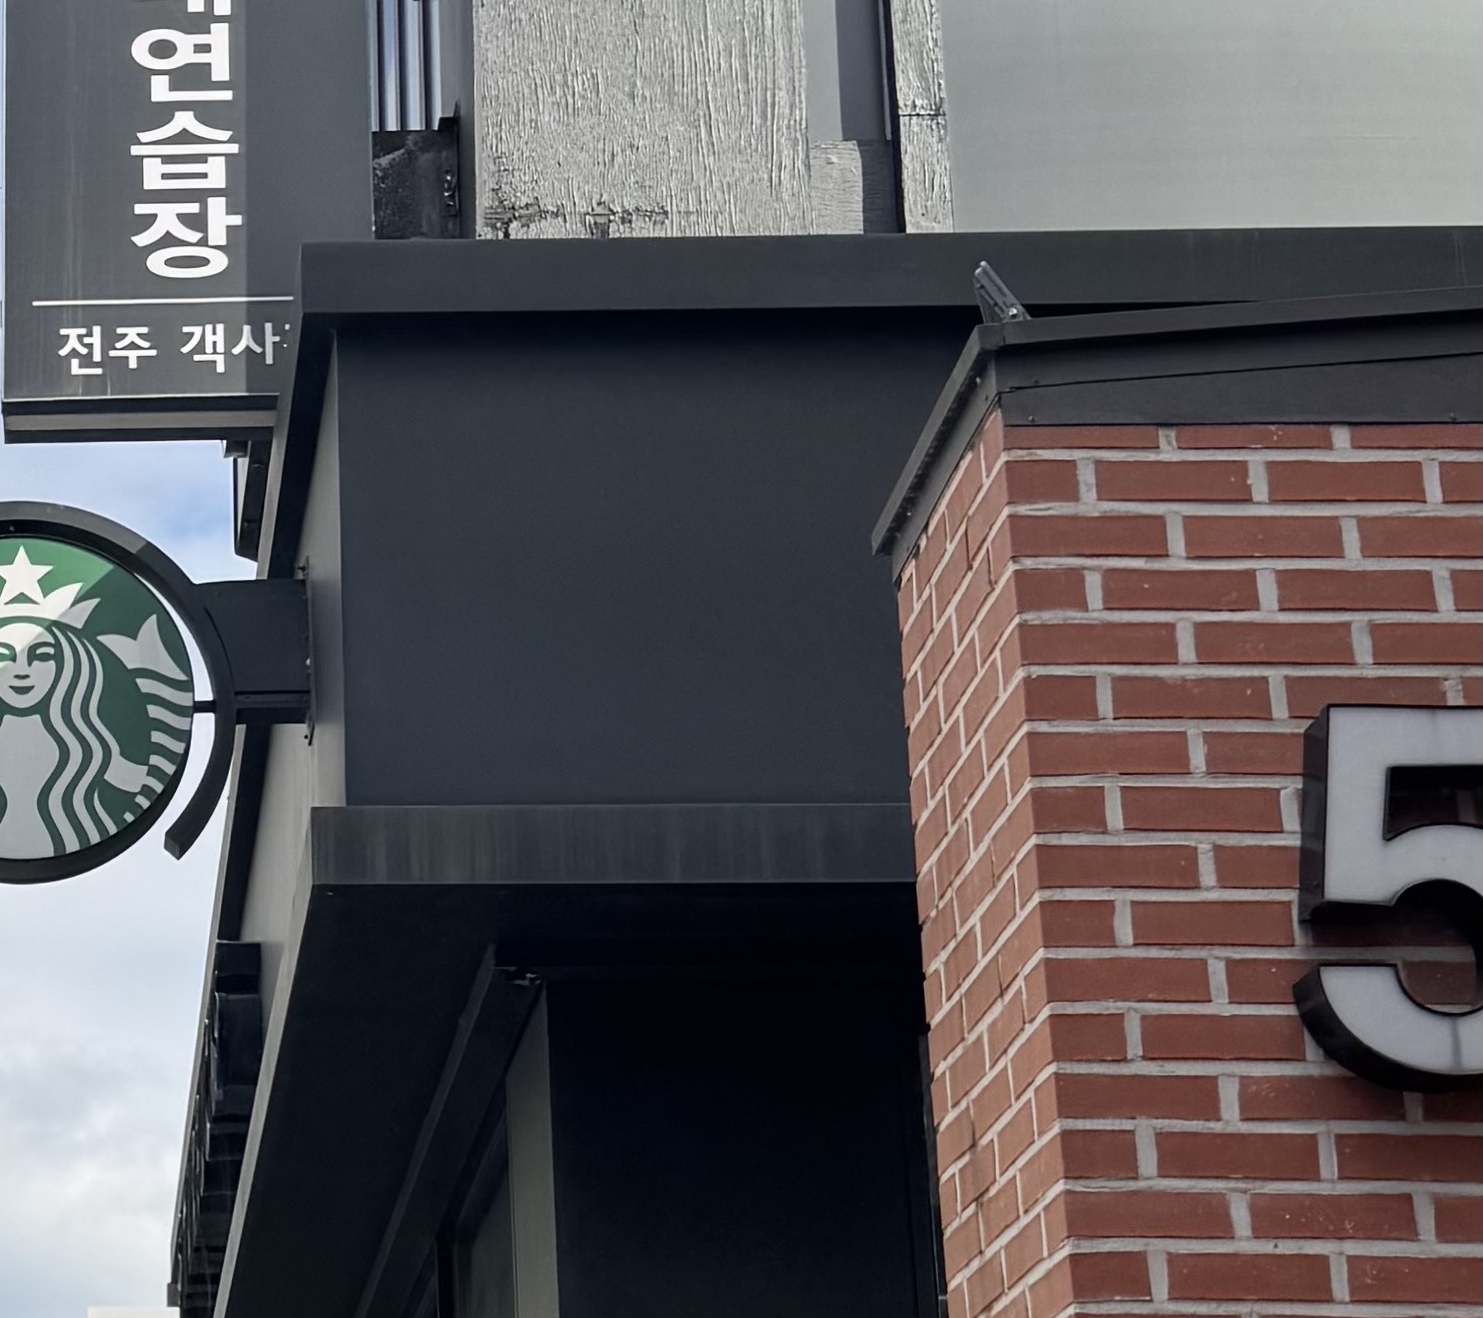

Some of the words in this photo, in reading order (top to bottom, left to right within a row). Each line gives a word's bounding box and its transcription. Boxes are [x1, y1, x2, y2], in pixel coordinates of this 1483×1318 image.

[131, 0, 243, 279] 연습장
[58, 322, 158, 375] 전주
[180, 322, 290, 374] 객사
[1298, 703, 1483, 1088] 5
